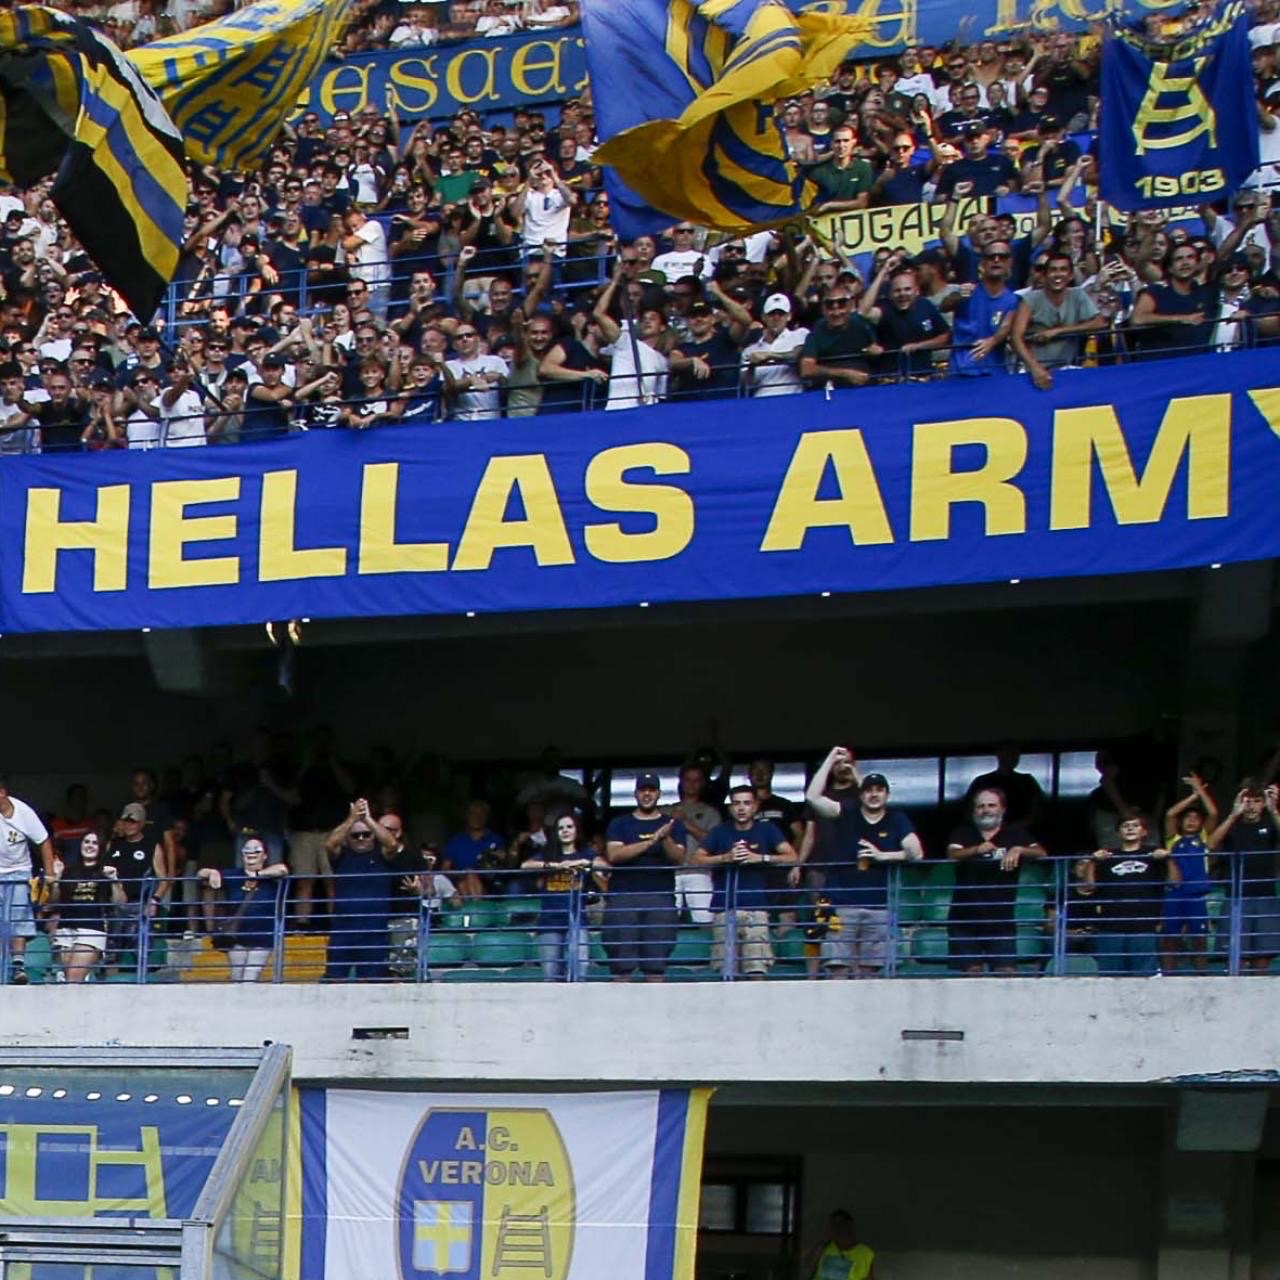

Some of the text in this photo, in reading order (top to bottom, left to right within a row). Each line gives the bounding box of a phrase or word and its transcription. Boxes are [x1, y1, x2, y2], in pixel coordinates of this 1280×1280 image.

[1135, 168, 1226, 199] 1903
[21, 386, 1280, 595] HELLAS ARM
[454, 1125, 519, 1152] A.C.
[417, 1159, 555, 1187] VERONA
